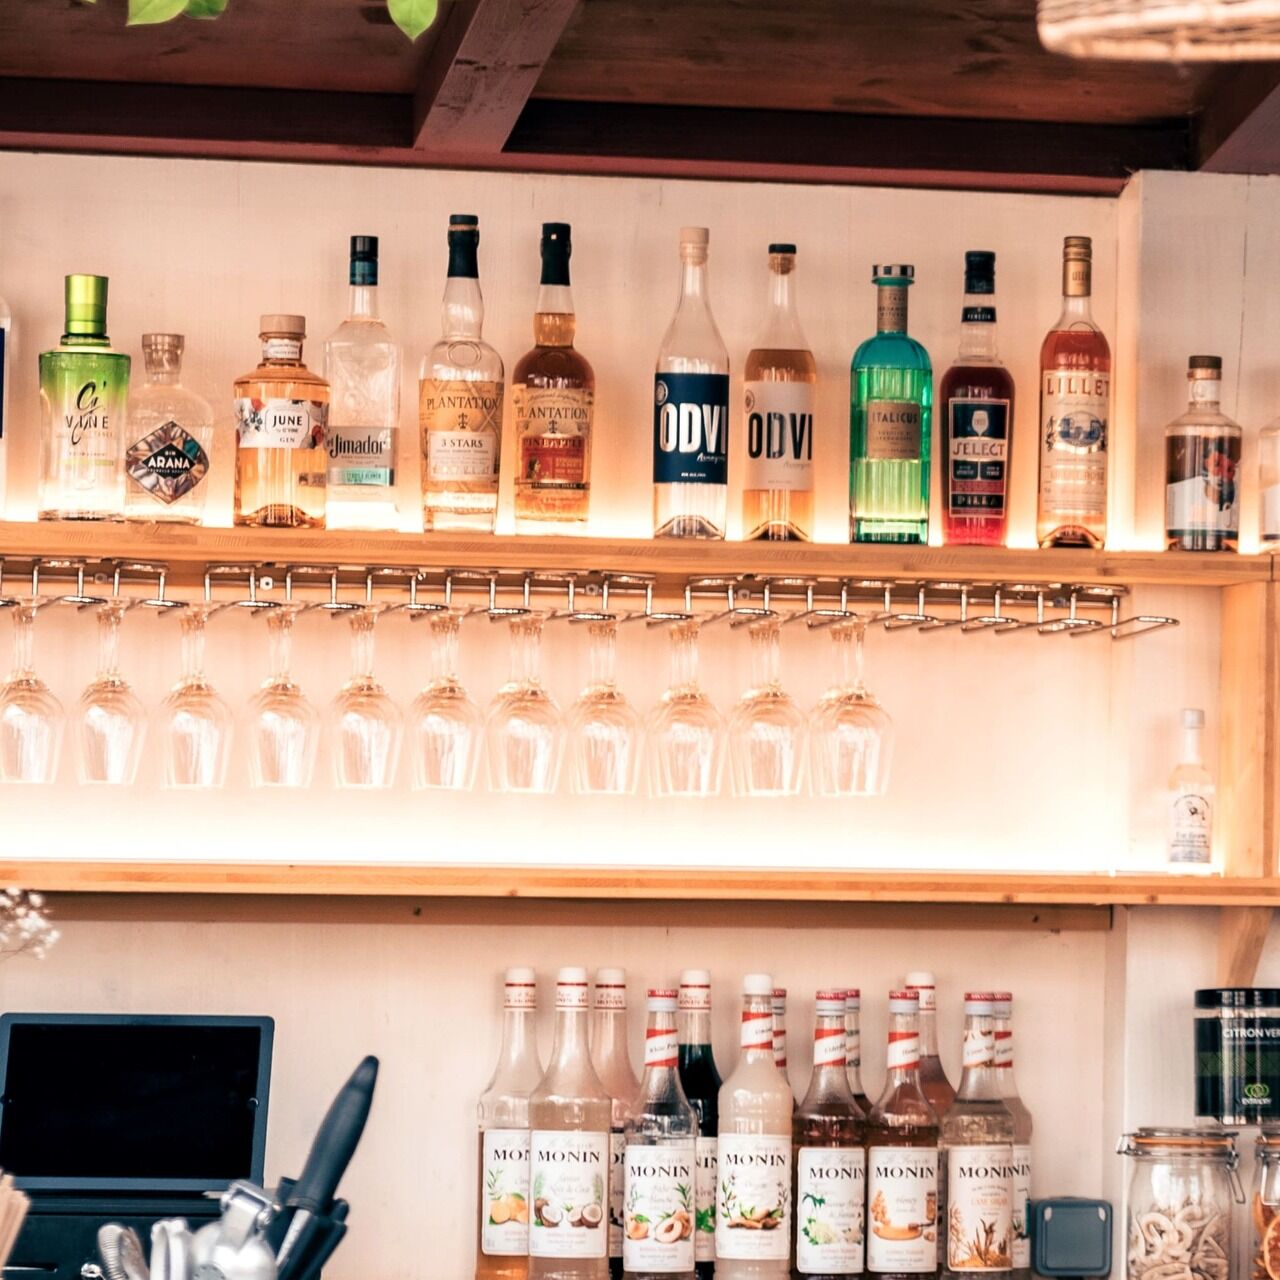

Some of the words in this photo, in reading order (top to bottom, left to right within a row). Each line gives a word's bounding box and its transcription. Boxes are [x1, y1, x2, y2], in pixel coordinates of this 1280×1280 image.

[426, 395, 500, 410] PLANTATION
[517, 406, 588, 419] PLANTATION
[872, 411, 918, 424] ITALICUS
[65, 416, 109, 429] VINE
[272, 415, 303, 427] JUNE
[660, 403, 726, 454] ODVI
[748, 412, 813, 460] ODVI
[330, 433, 386, 458] Jimador
[441, 439, 447, 448] 3
[450, 439, 483, 448] STARS
[952, 442, 1005, 457] SELECT
[147, 455, 190, 469] ARANA
[1223, 1028, 1263, 1038] CITRON
[538, 1150, 600, 1163] MONIN
[726, 1153, 786, 1166] MONIN
[630, 1165, 690, 1178] MONIN
[876, 1166, 934, 1179] MONIN
[959, 1166, 1013, 1179] MONIN
